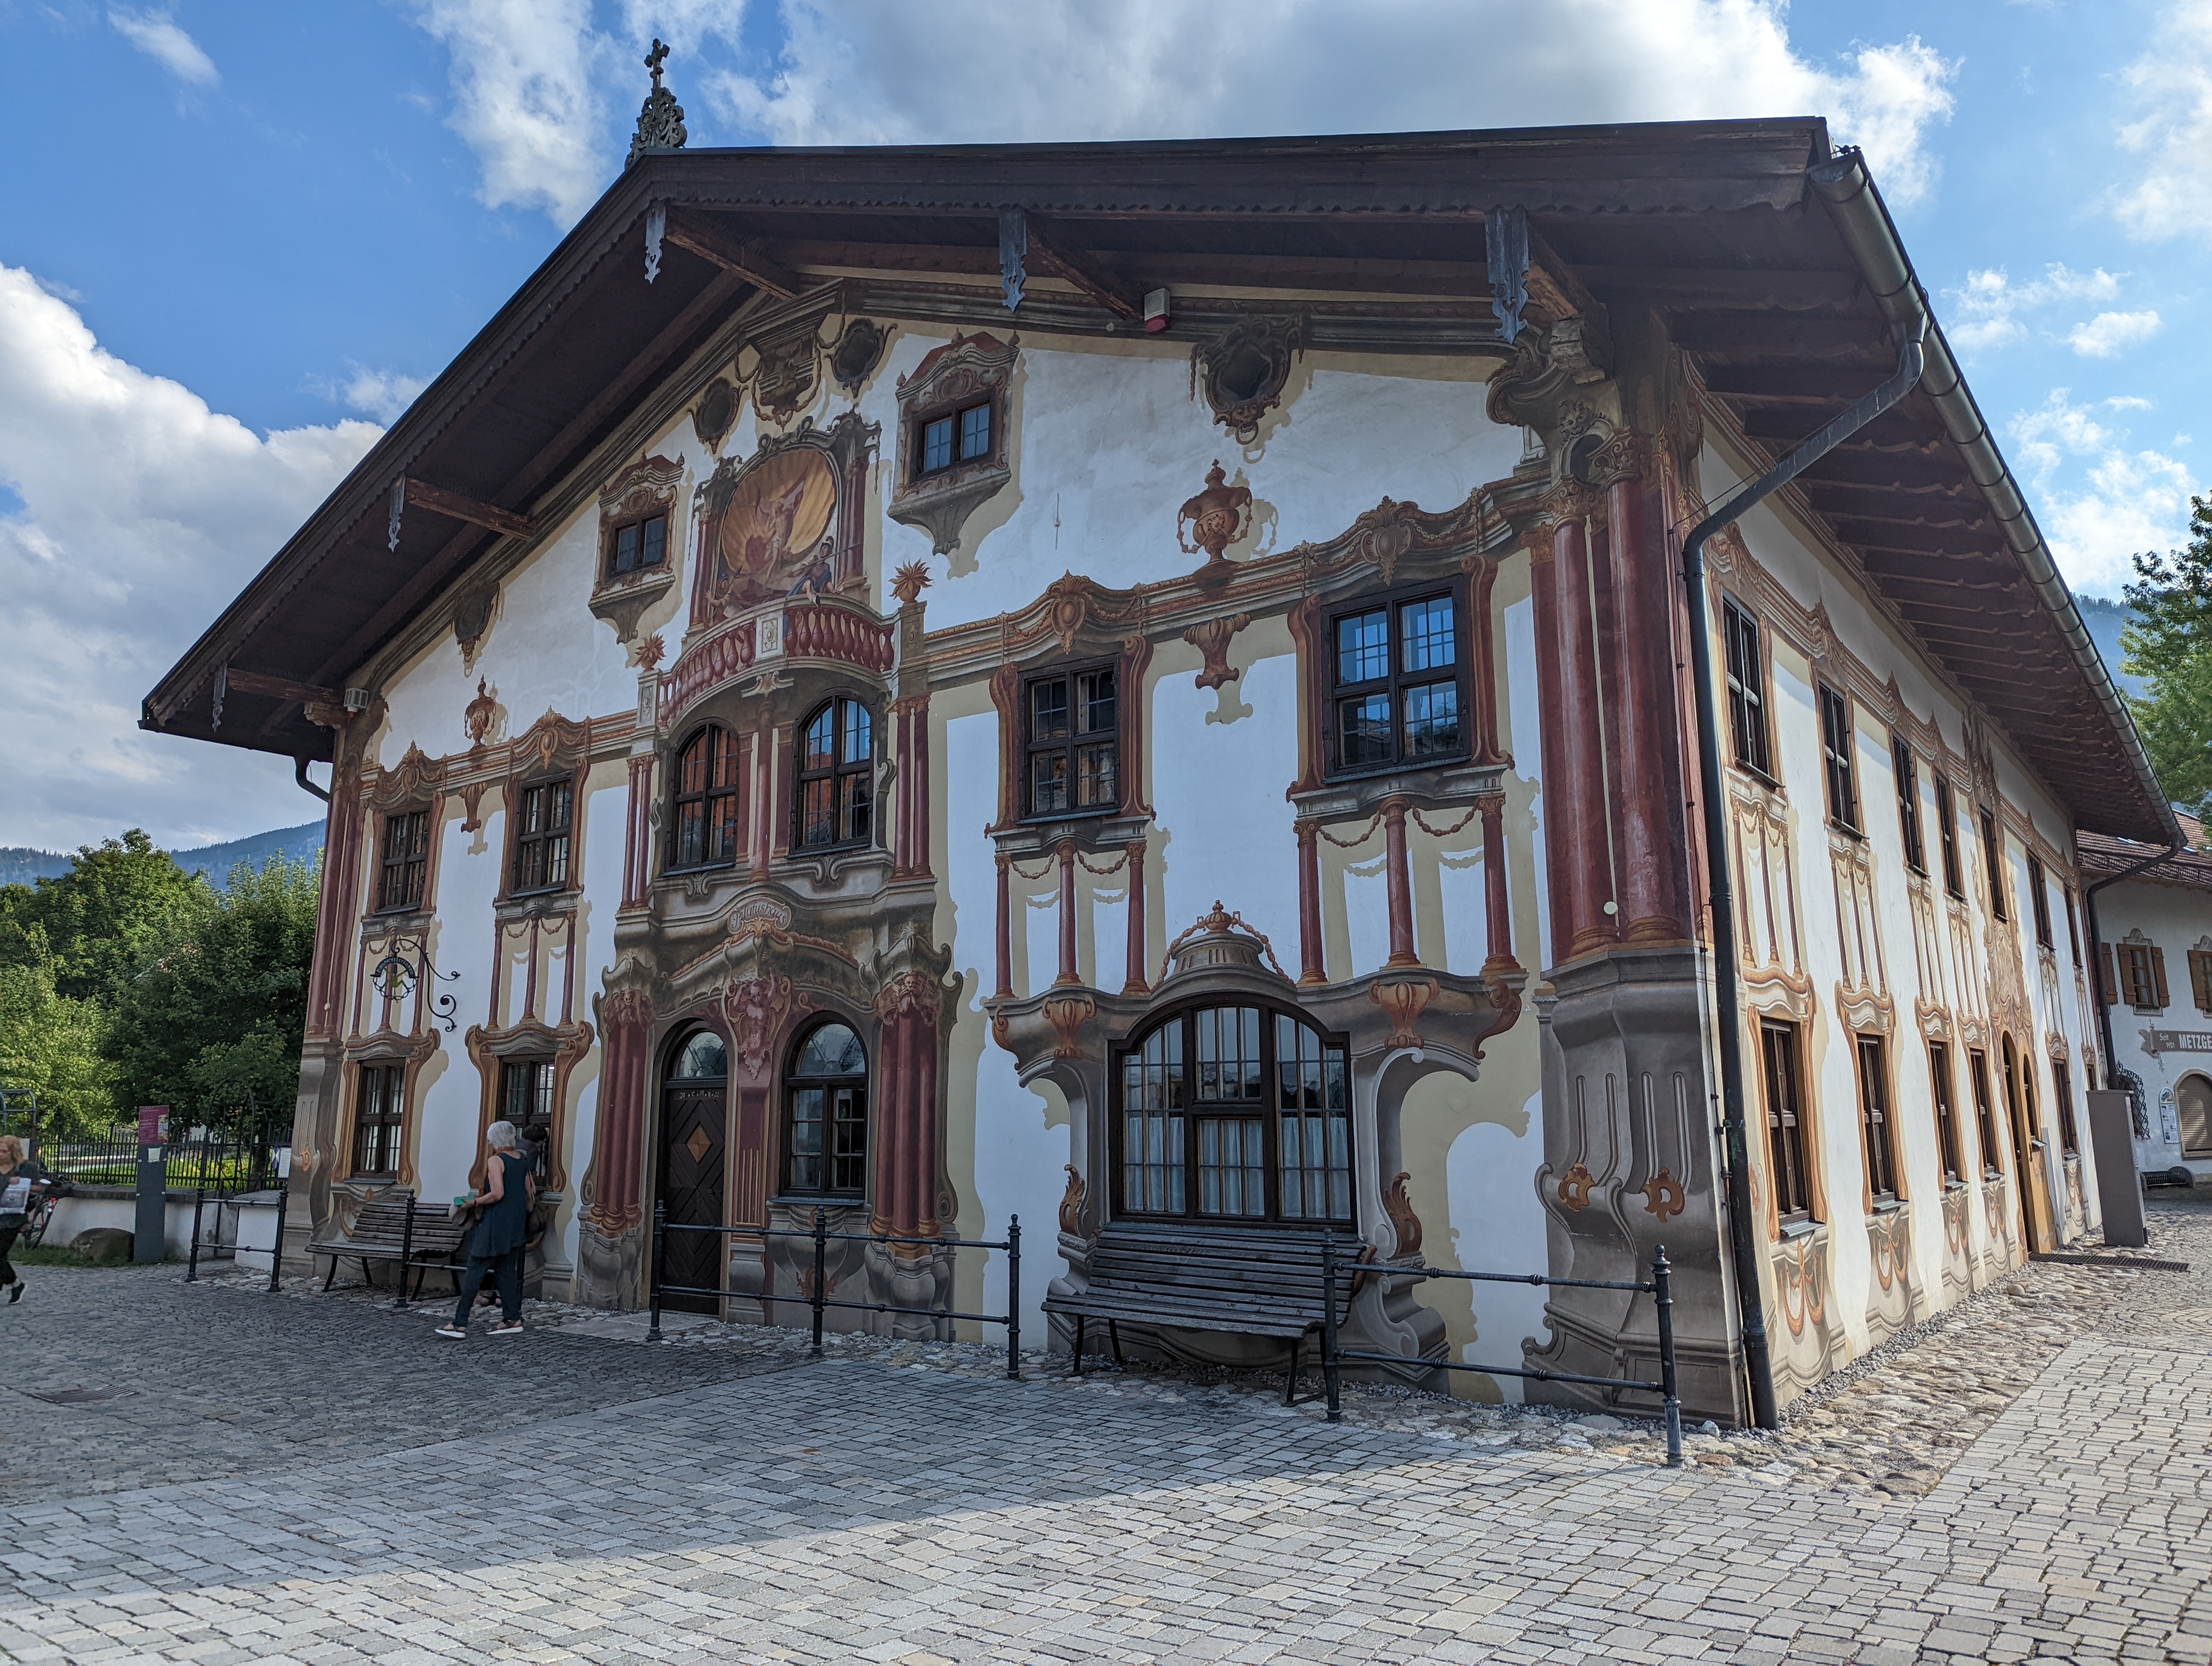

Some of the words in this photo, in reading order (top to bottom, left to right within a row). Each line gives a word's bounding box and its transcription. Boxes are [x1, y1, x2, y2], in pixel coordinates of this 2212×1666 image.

[731, 901, 786, 929] Pilatushaus
[2159, 1033, 2169, 1041] Seit
[2178, 1034, 2212, 1049] METZGE
